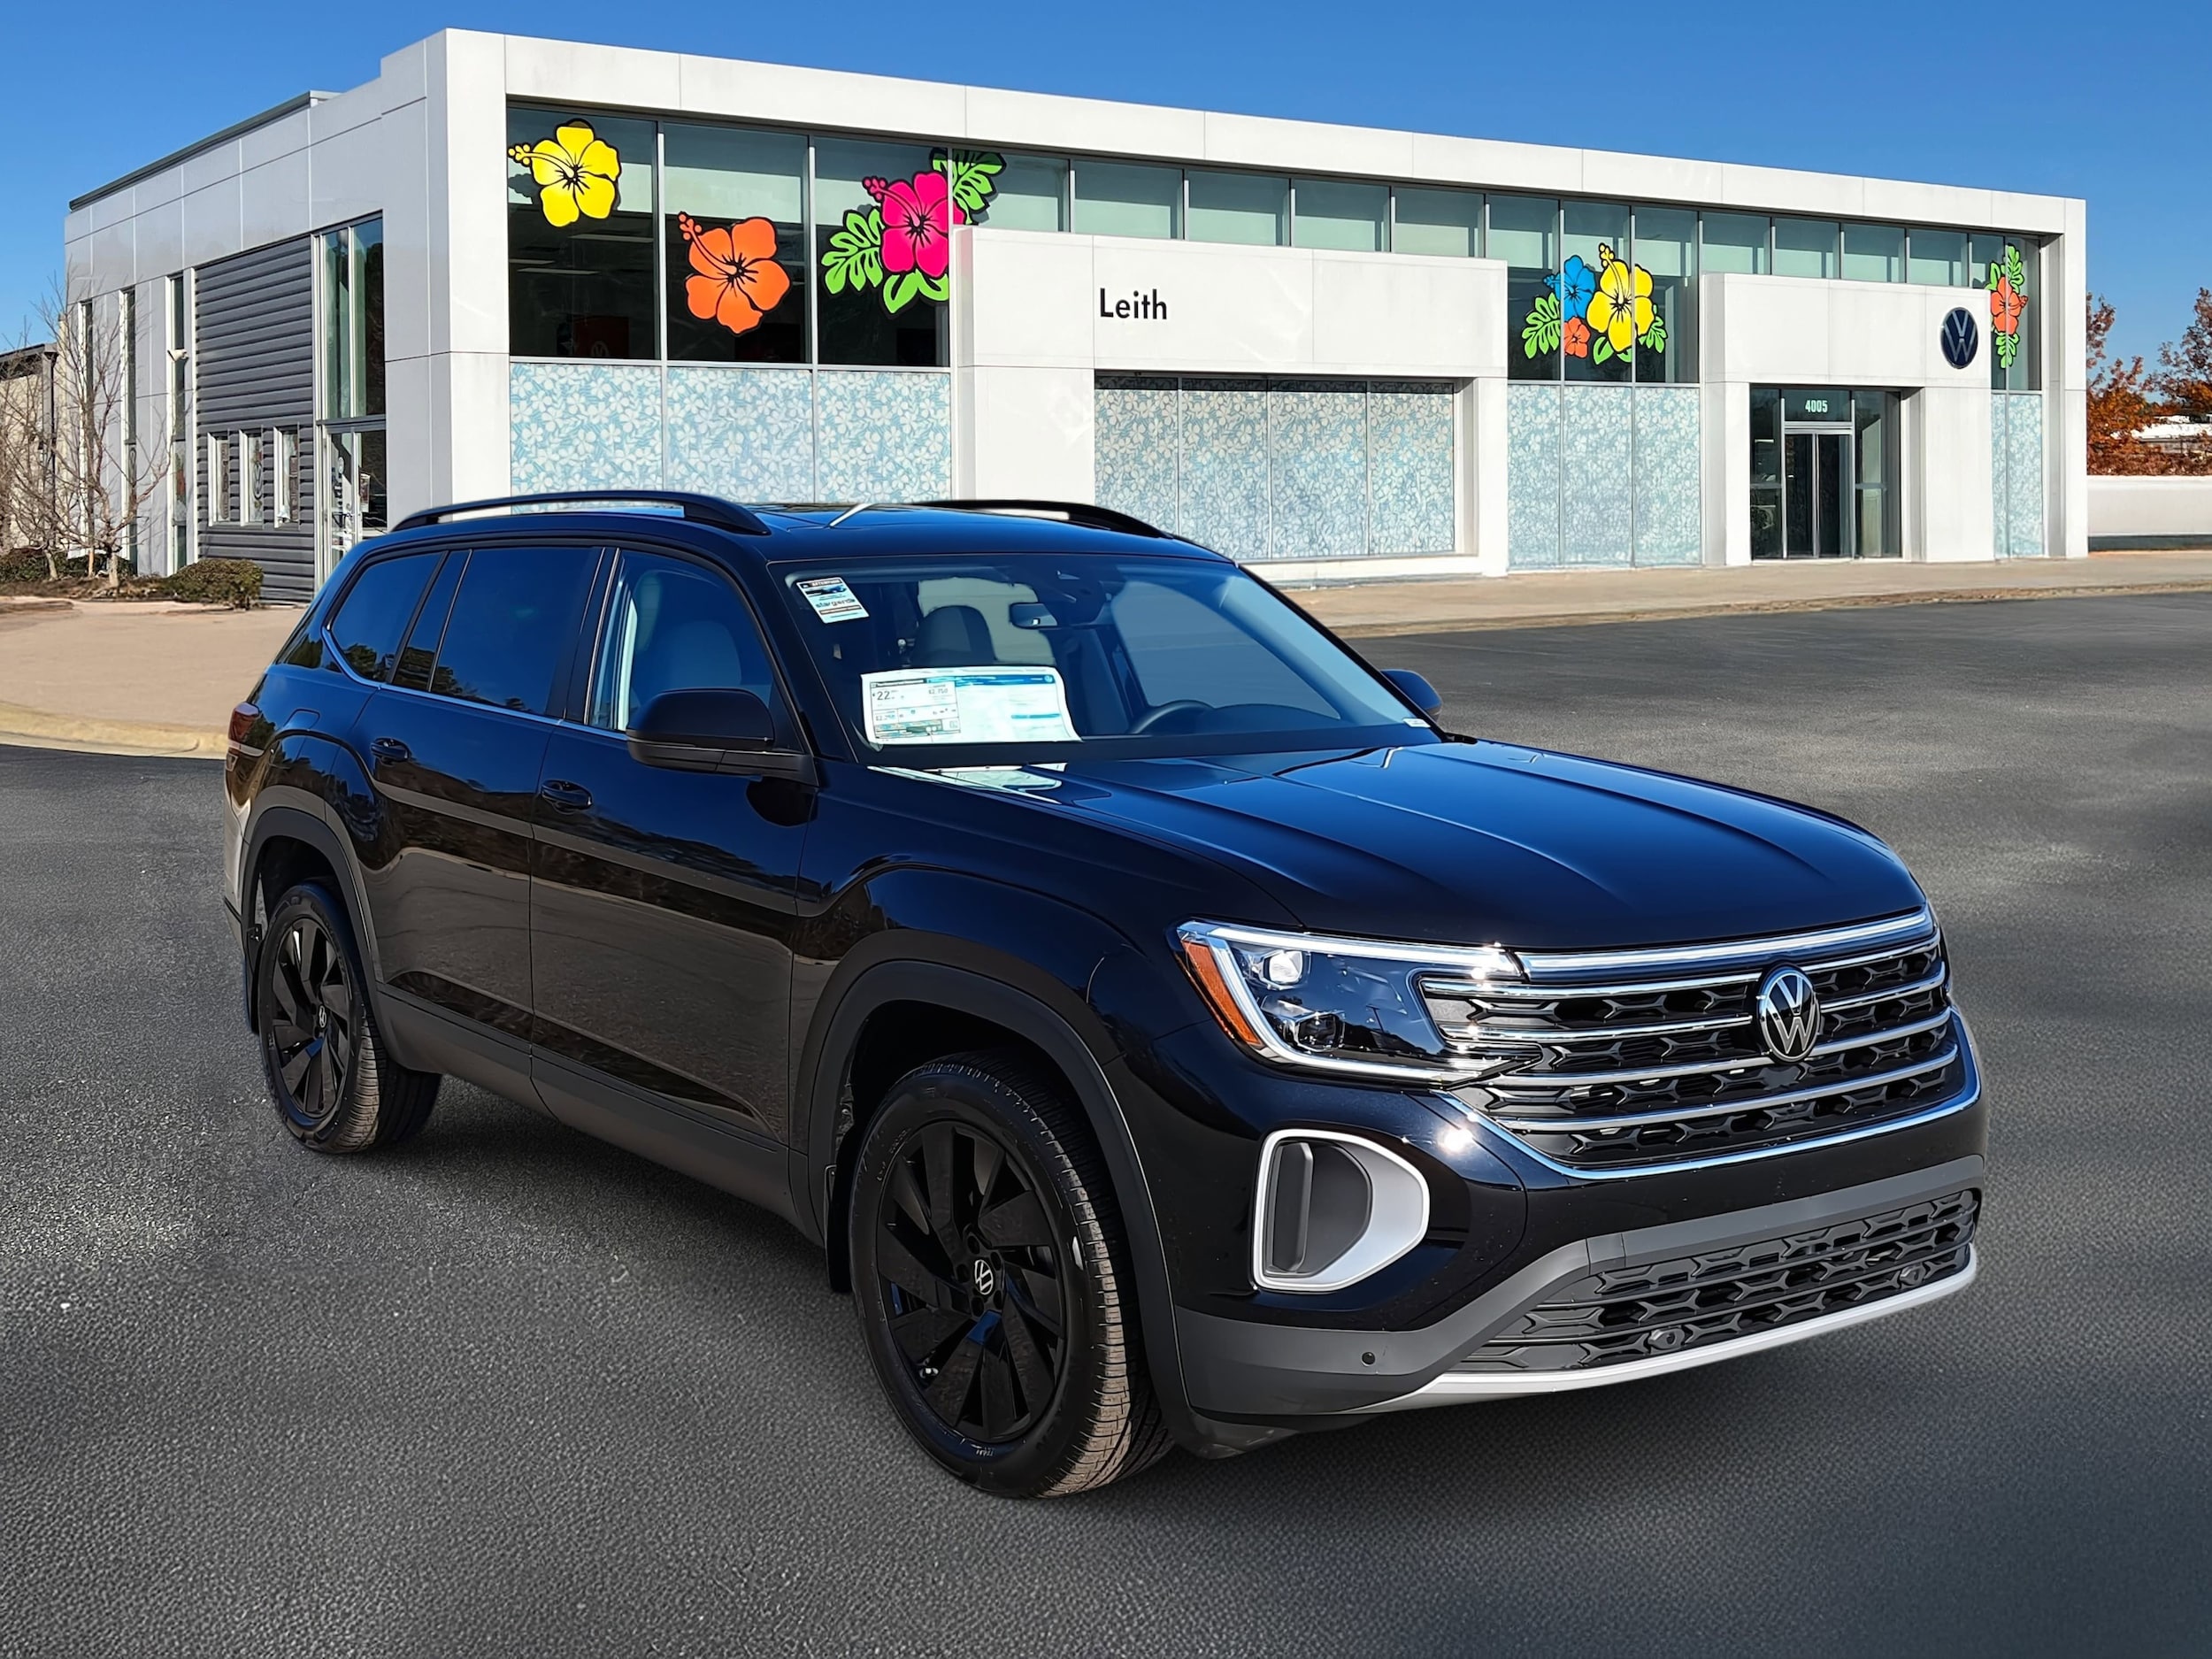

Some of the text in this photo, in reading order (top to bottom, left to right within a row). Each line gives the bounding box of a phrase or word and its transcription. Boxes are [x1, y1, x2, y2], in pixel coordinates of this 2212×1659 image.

[1100, 288, 1168, 320] Leith
[1805, 399, 1829, 413] 4005
[876, 691, 890, 701] 22
[1763, 971, 1817, 1057] VW
